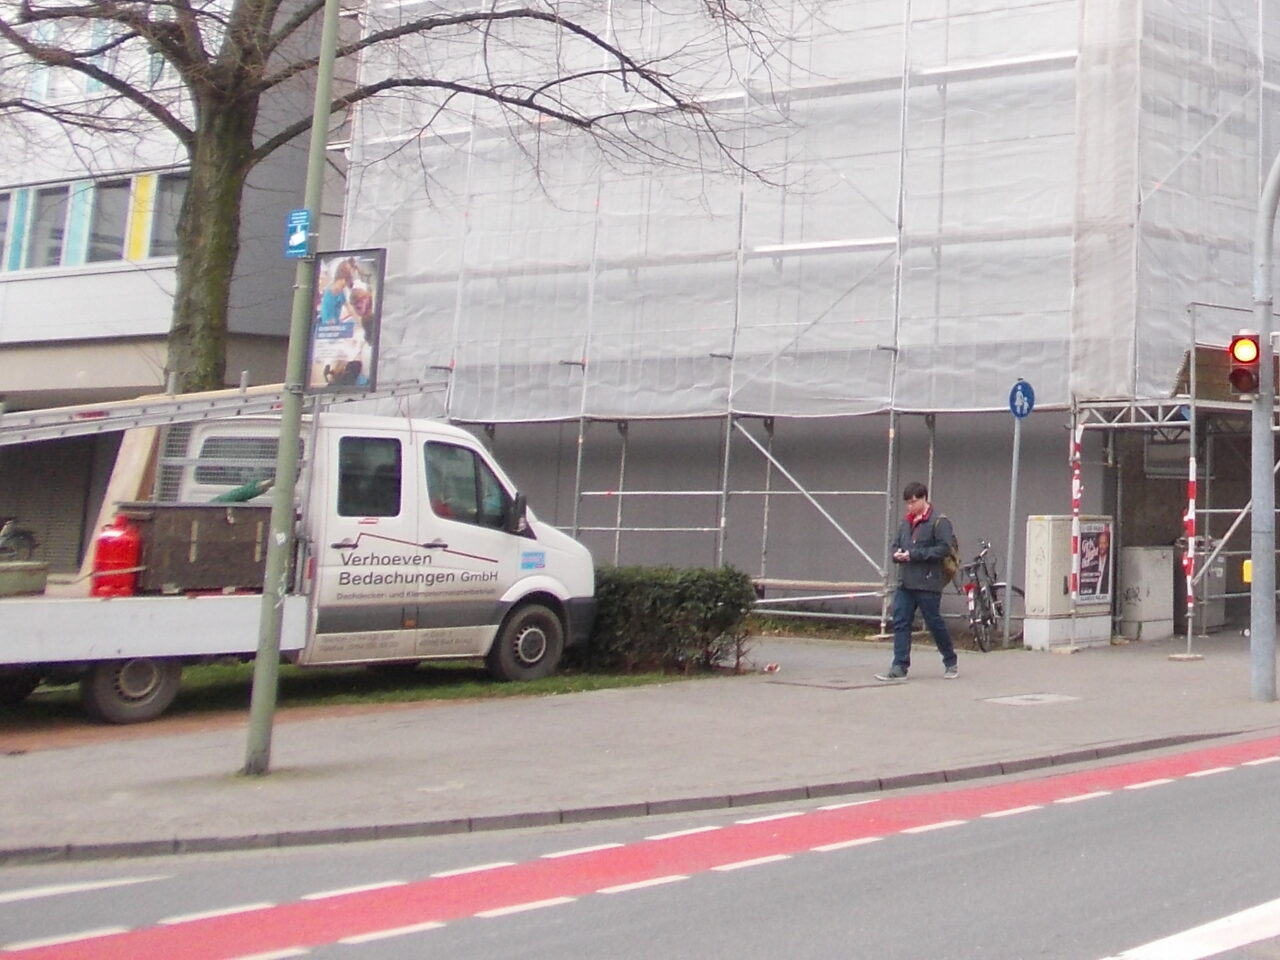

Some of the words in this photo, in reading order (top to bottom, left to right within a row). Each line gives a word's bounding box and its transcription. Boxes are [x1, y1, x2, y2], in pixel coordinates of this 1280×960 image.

[341, 552, 432, 566] Verhoeven
[339, 571, 455, 586] Bedachungen
[460, 571, 498, 582] GmbH
[389, 591, 405, 599] und
